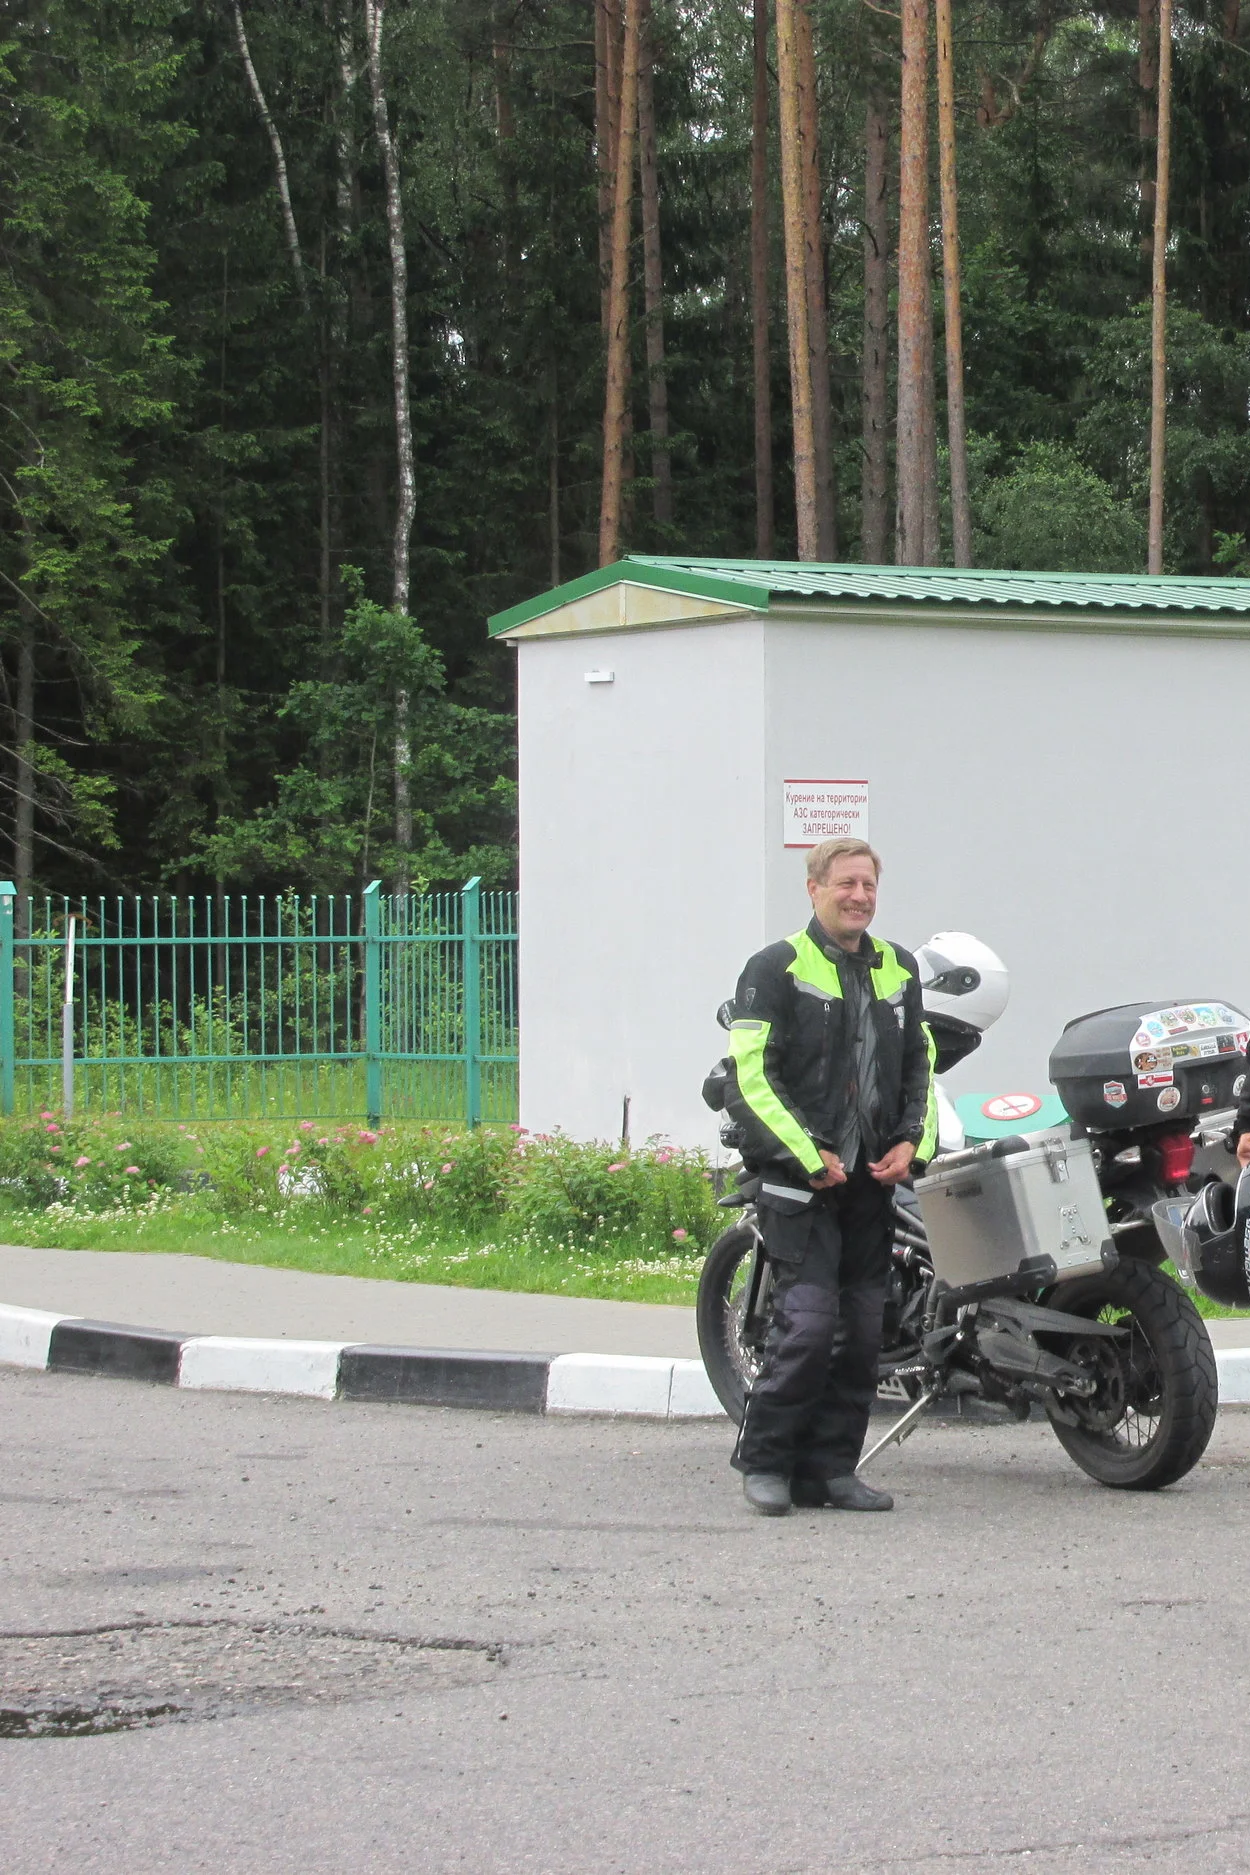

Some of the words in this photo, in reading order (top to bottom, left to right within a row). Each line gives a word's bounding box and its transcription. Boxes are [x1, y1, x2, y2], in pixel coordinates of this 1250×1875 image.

[786, 792, 815, 805] Курение
[816, 795, 825, 803] на
[826, 794, 867, 805] территории
[794, 808, 808, 818] АЗС
[809, 810, 860, 820] категорически
[802, 823, 851, 834] ЗАПРЕЩЕНО!
